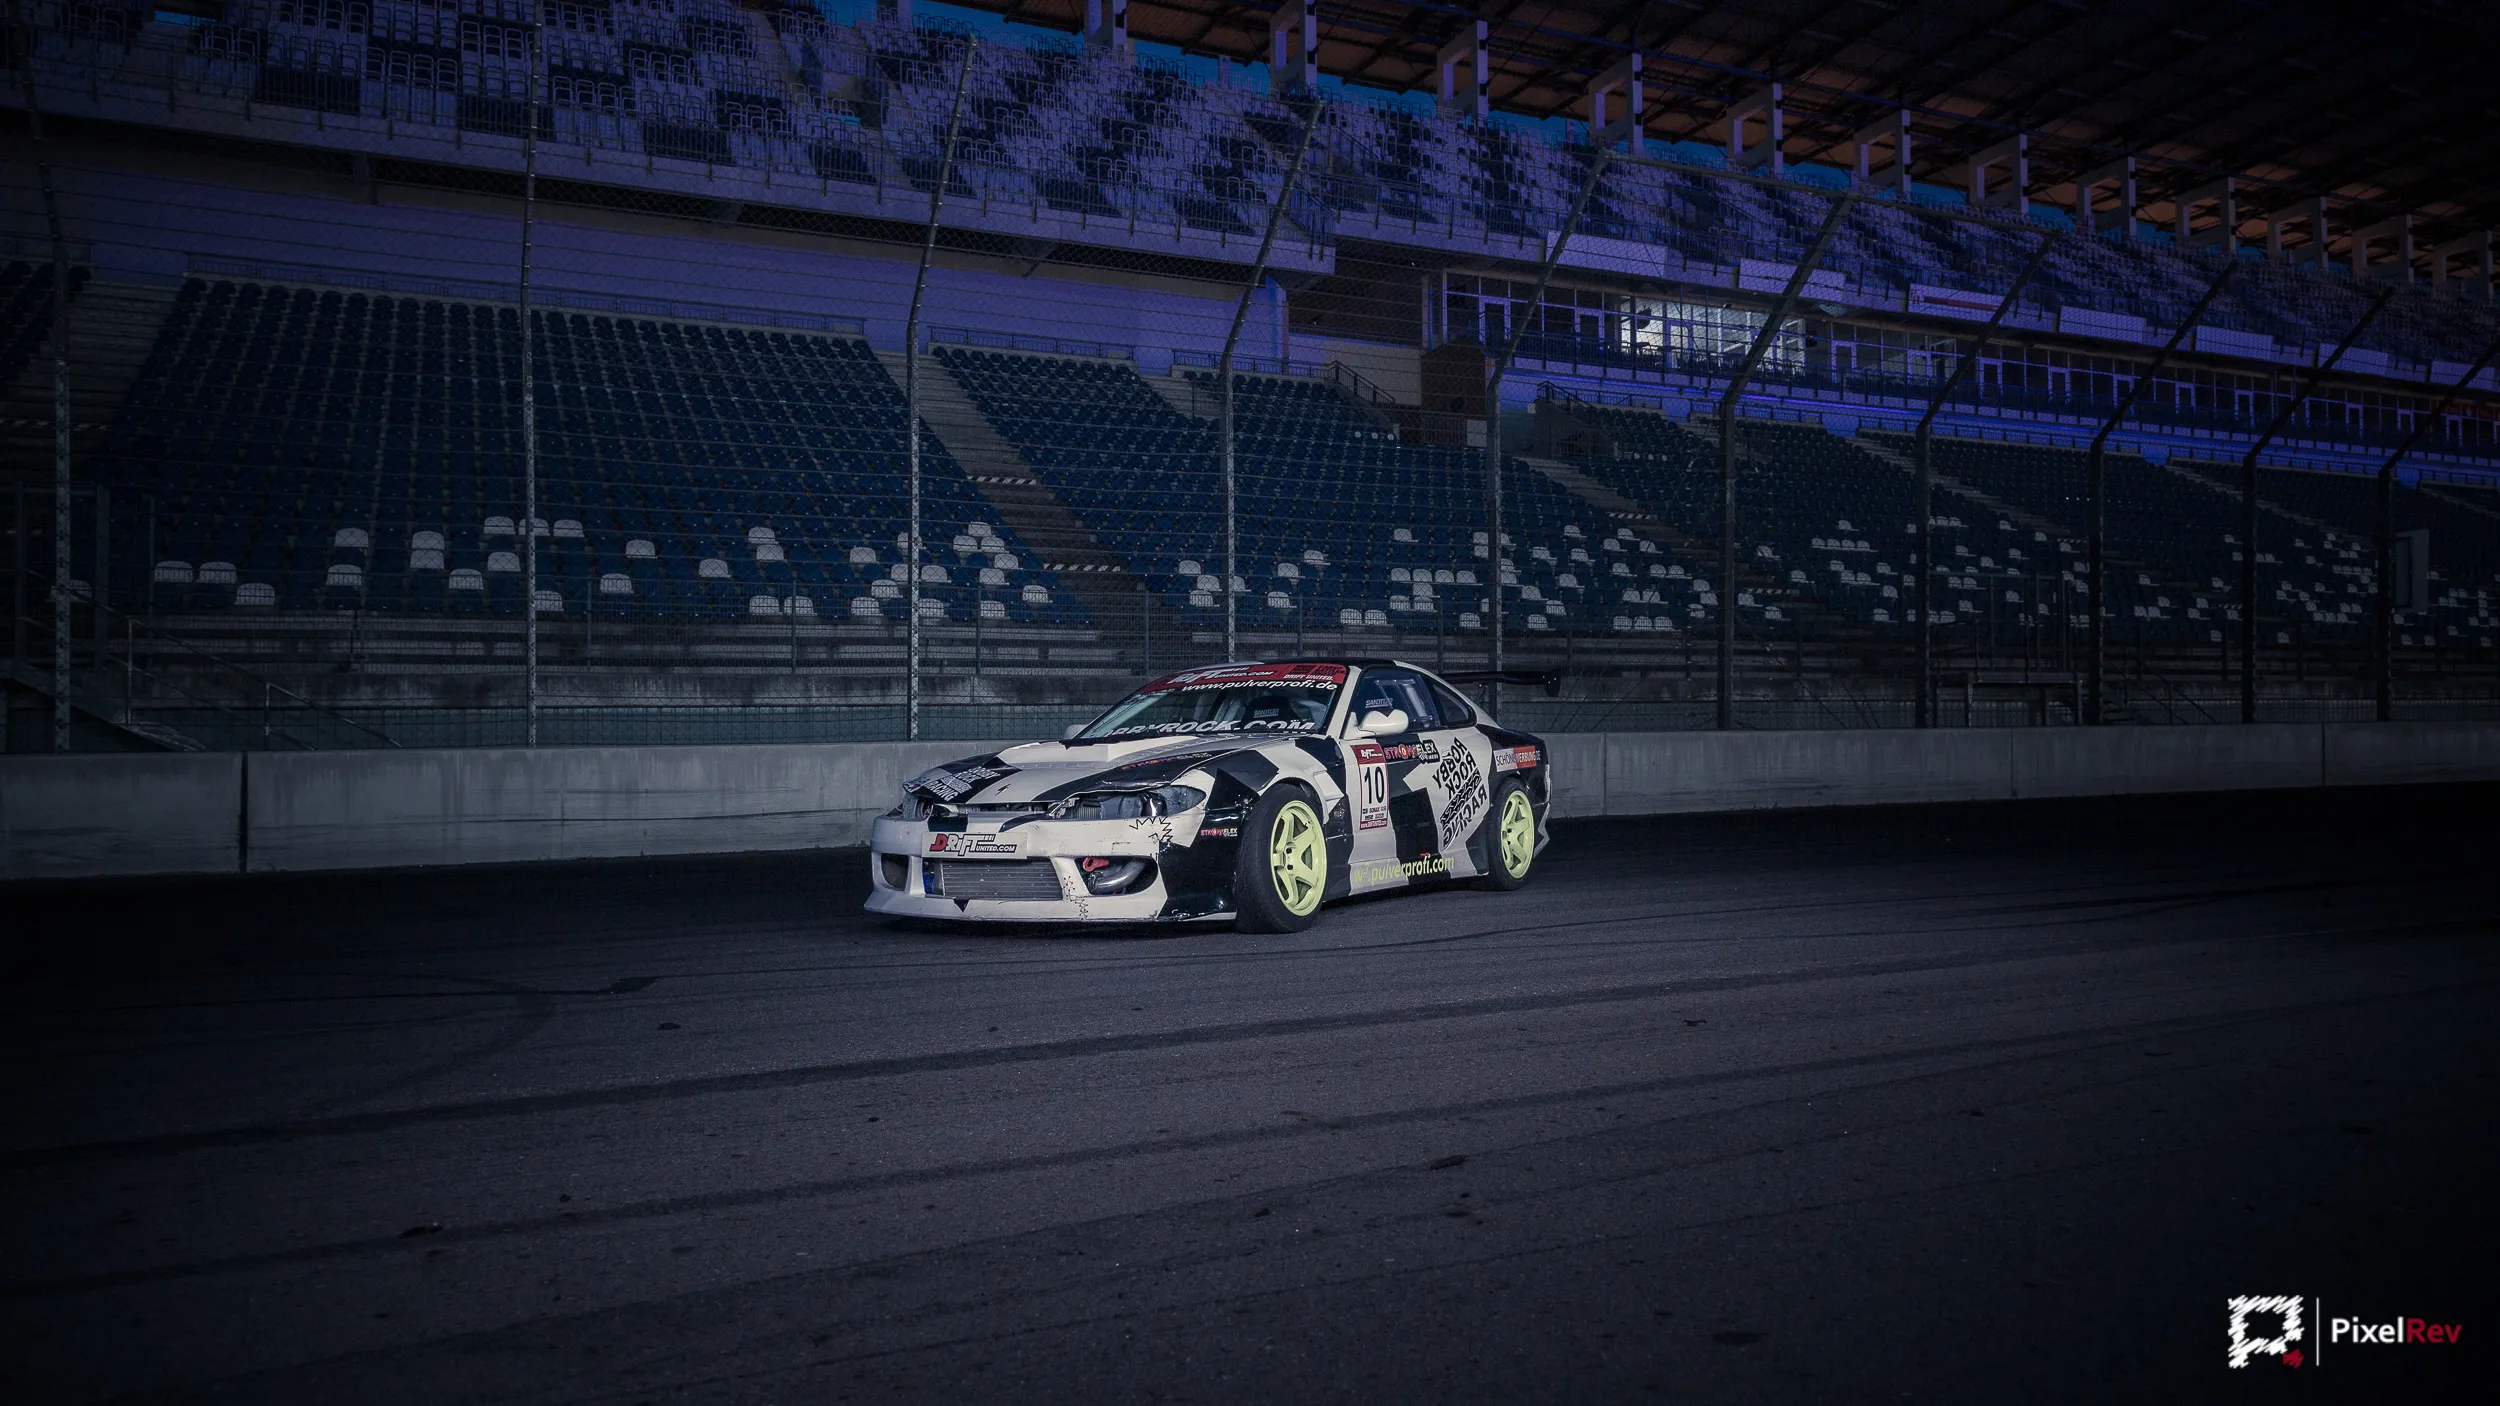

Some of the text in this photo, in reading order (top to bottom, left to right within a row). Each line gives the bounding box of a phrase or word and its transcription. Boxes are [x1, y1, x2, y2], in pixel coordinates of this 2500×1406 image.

[1181, 679, 1338, 691] www.pulverprofi.de
[1364, 765, 1385, 804] 10
[975, 844, 1017, 853] UNITED.COM
